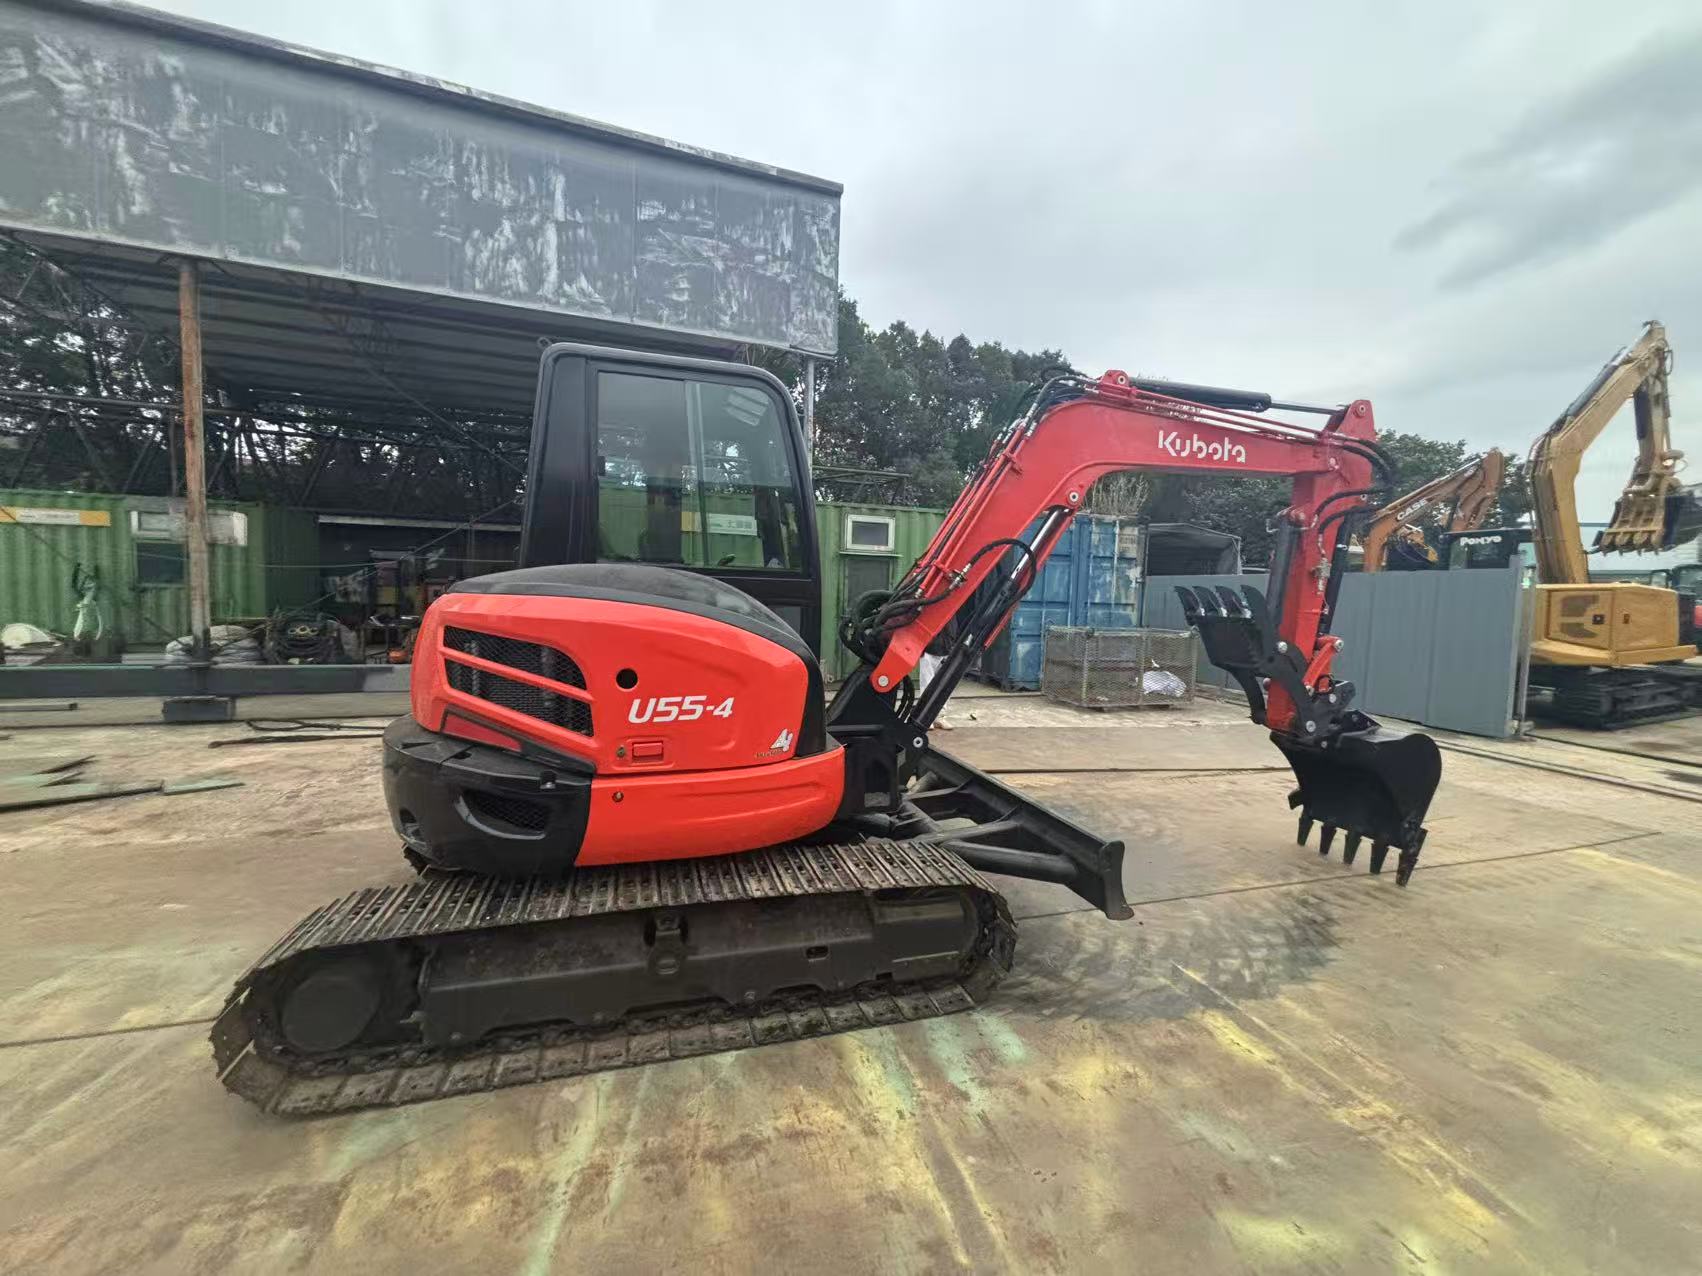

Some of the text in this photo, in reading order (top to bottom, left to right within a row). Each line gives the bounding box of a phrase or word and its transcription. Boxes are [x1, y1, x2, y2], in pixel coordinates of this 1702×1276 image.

[1158, 430, 1246, 464] Kubota
[1397, 499, 1429, 521] CASE
[628, 695, 735, 724] U55-4
